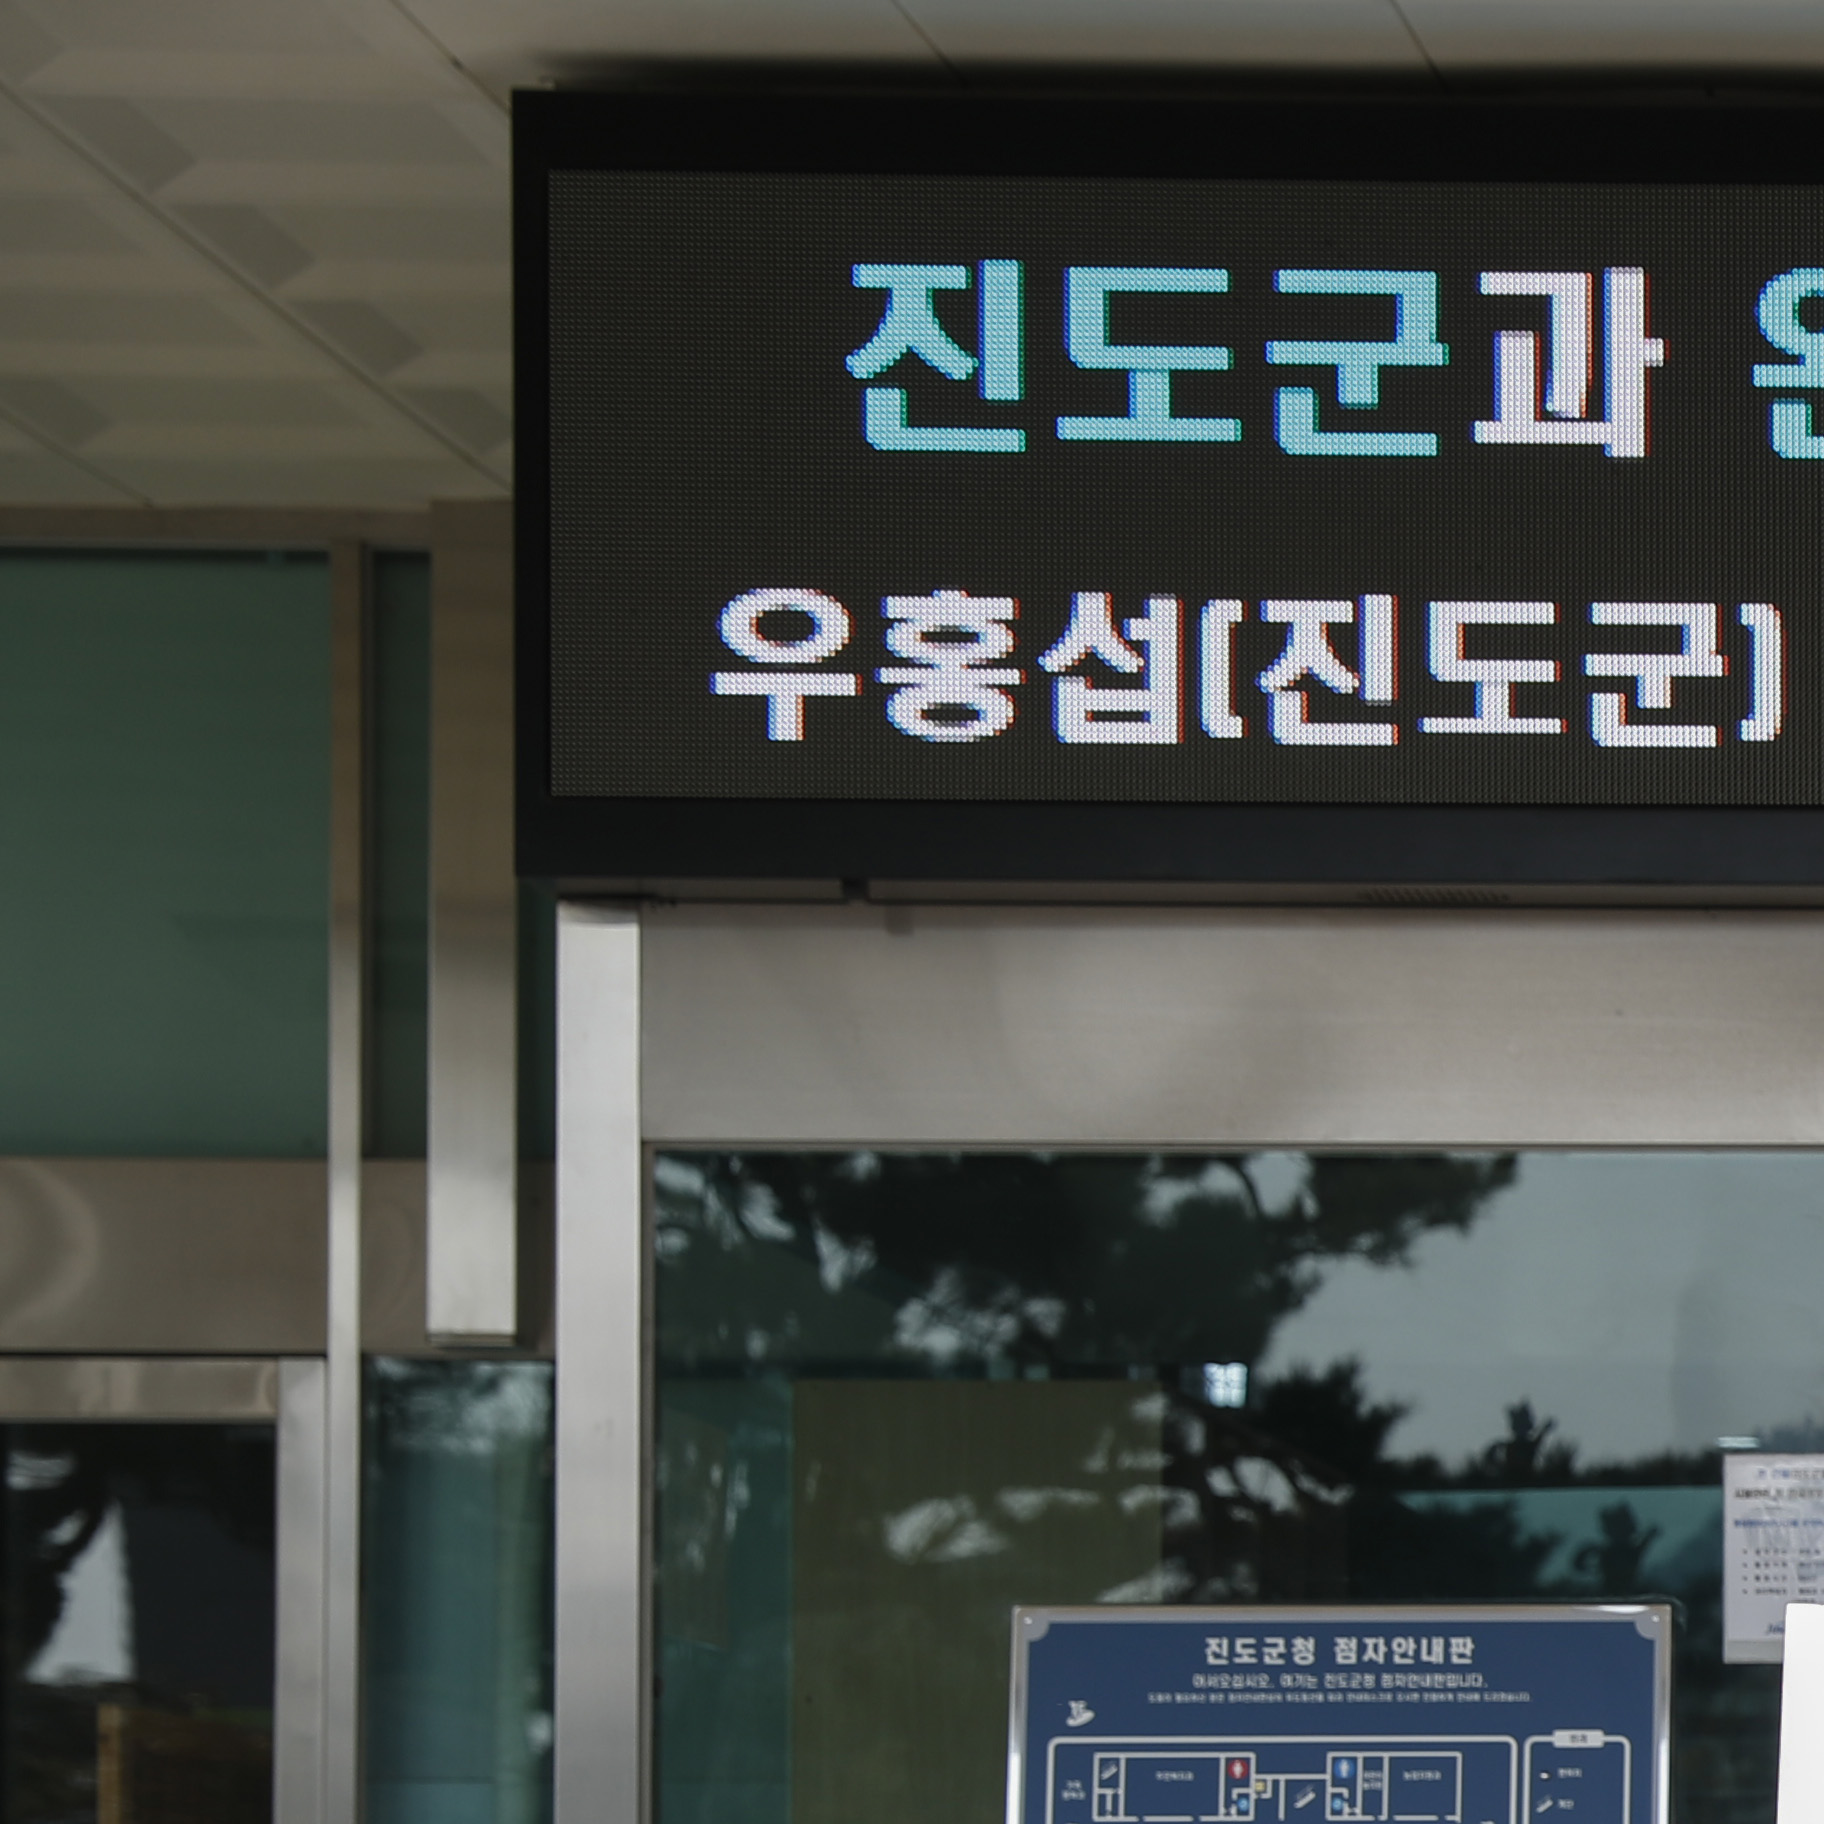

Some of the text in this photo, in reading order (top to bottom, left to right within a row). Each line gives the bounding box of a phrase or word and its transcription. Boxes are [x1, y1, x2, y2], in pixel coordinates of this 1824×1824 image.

[846, 258, 1665, 457] 진도군과
[709, 588, 1783, 749] 우홍섭(진도군)
[1204, 1636, 1475, 1666] 진도군청 점자안내판
